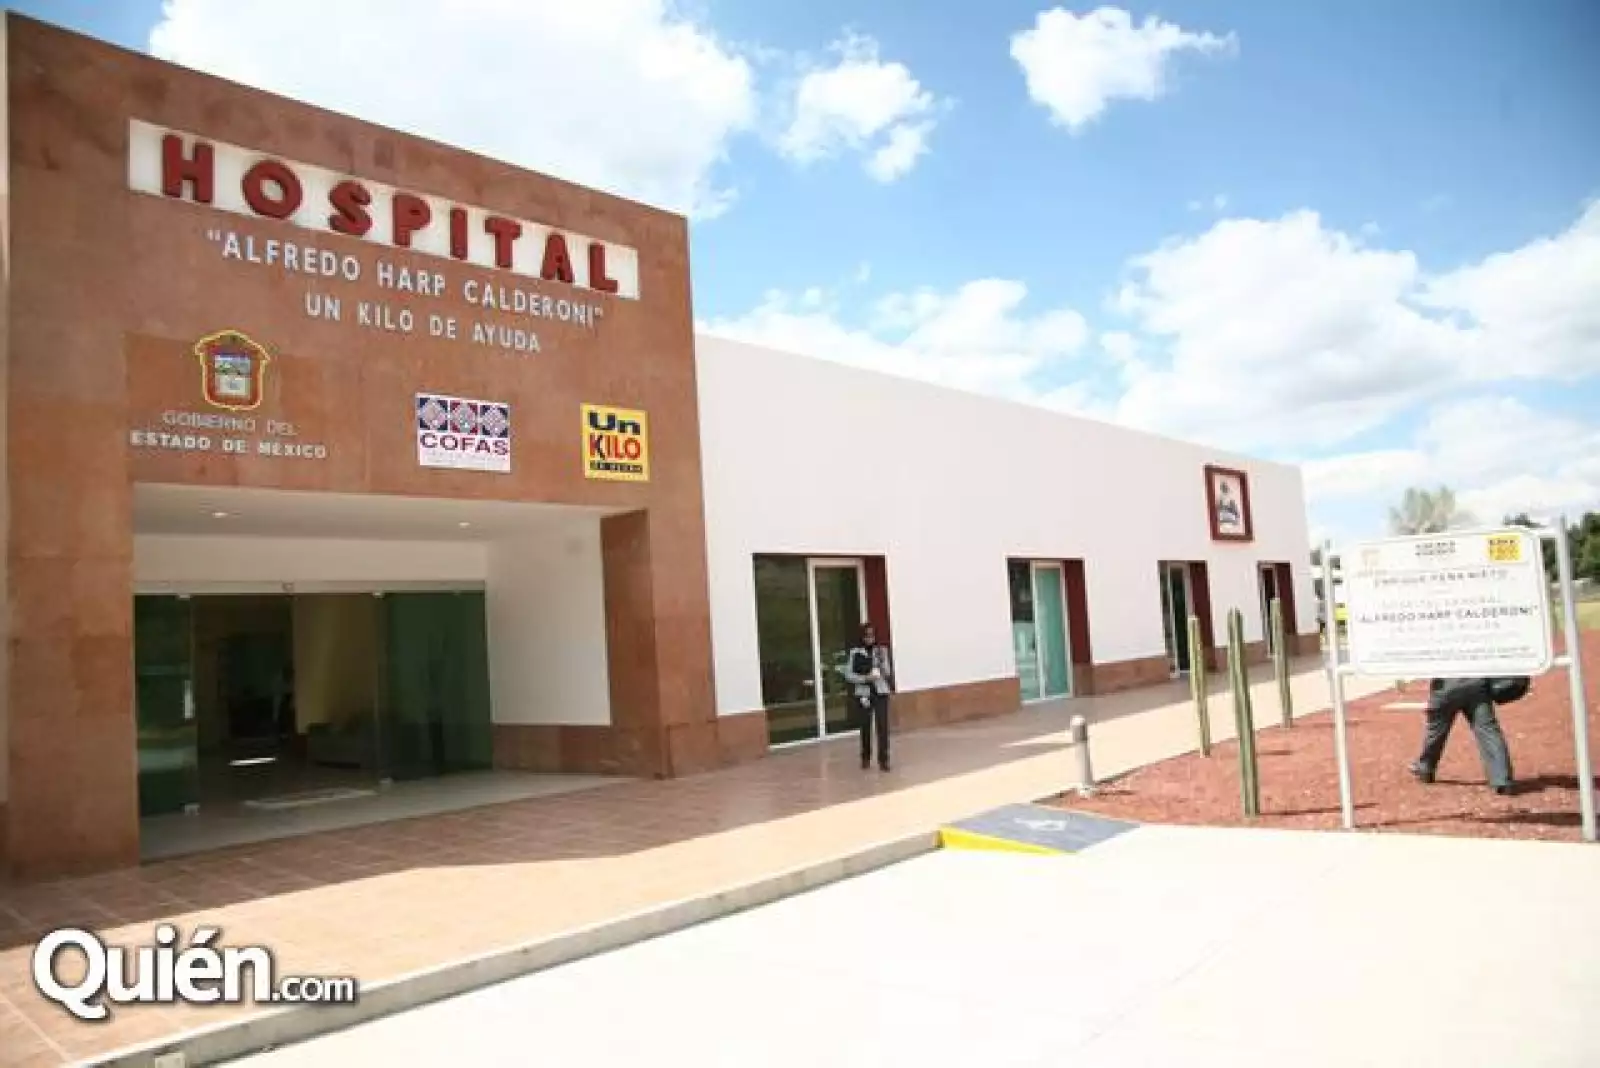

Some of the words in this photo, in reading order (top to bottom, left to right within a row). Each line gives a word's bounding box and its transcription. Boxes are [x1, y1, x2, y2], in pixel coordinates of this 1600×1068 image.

[161, 133, 618, 294] HOSPITAL
[207, 229, 360, 281] "ALFREDO
[377, 260, 446, 298] HARP
[464, 279, 604, 328] CALDERONI"
[305, 292, 342, 322] UN
[358, 301, 415, 332] KILO
[430, 316, 457, 340] DE
[473, 322, 541, 354] AYUDA
[588, 411, 641, 435] Un
[129, 429, 211, 451] ESTADO
[222, 438, 249, 454] DE
[419, 432, 510, 456] COFAS
[588, 433, 642, 461] KILO
